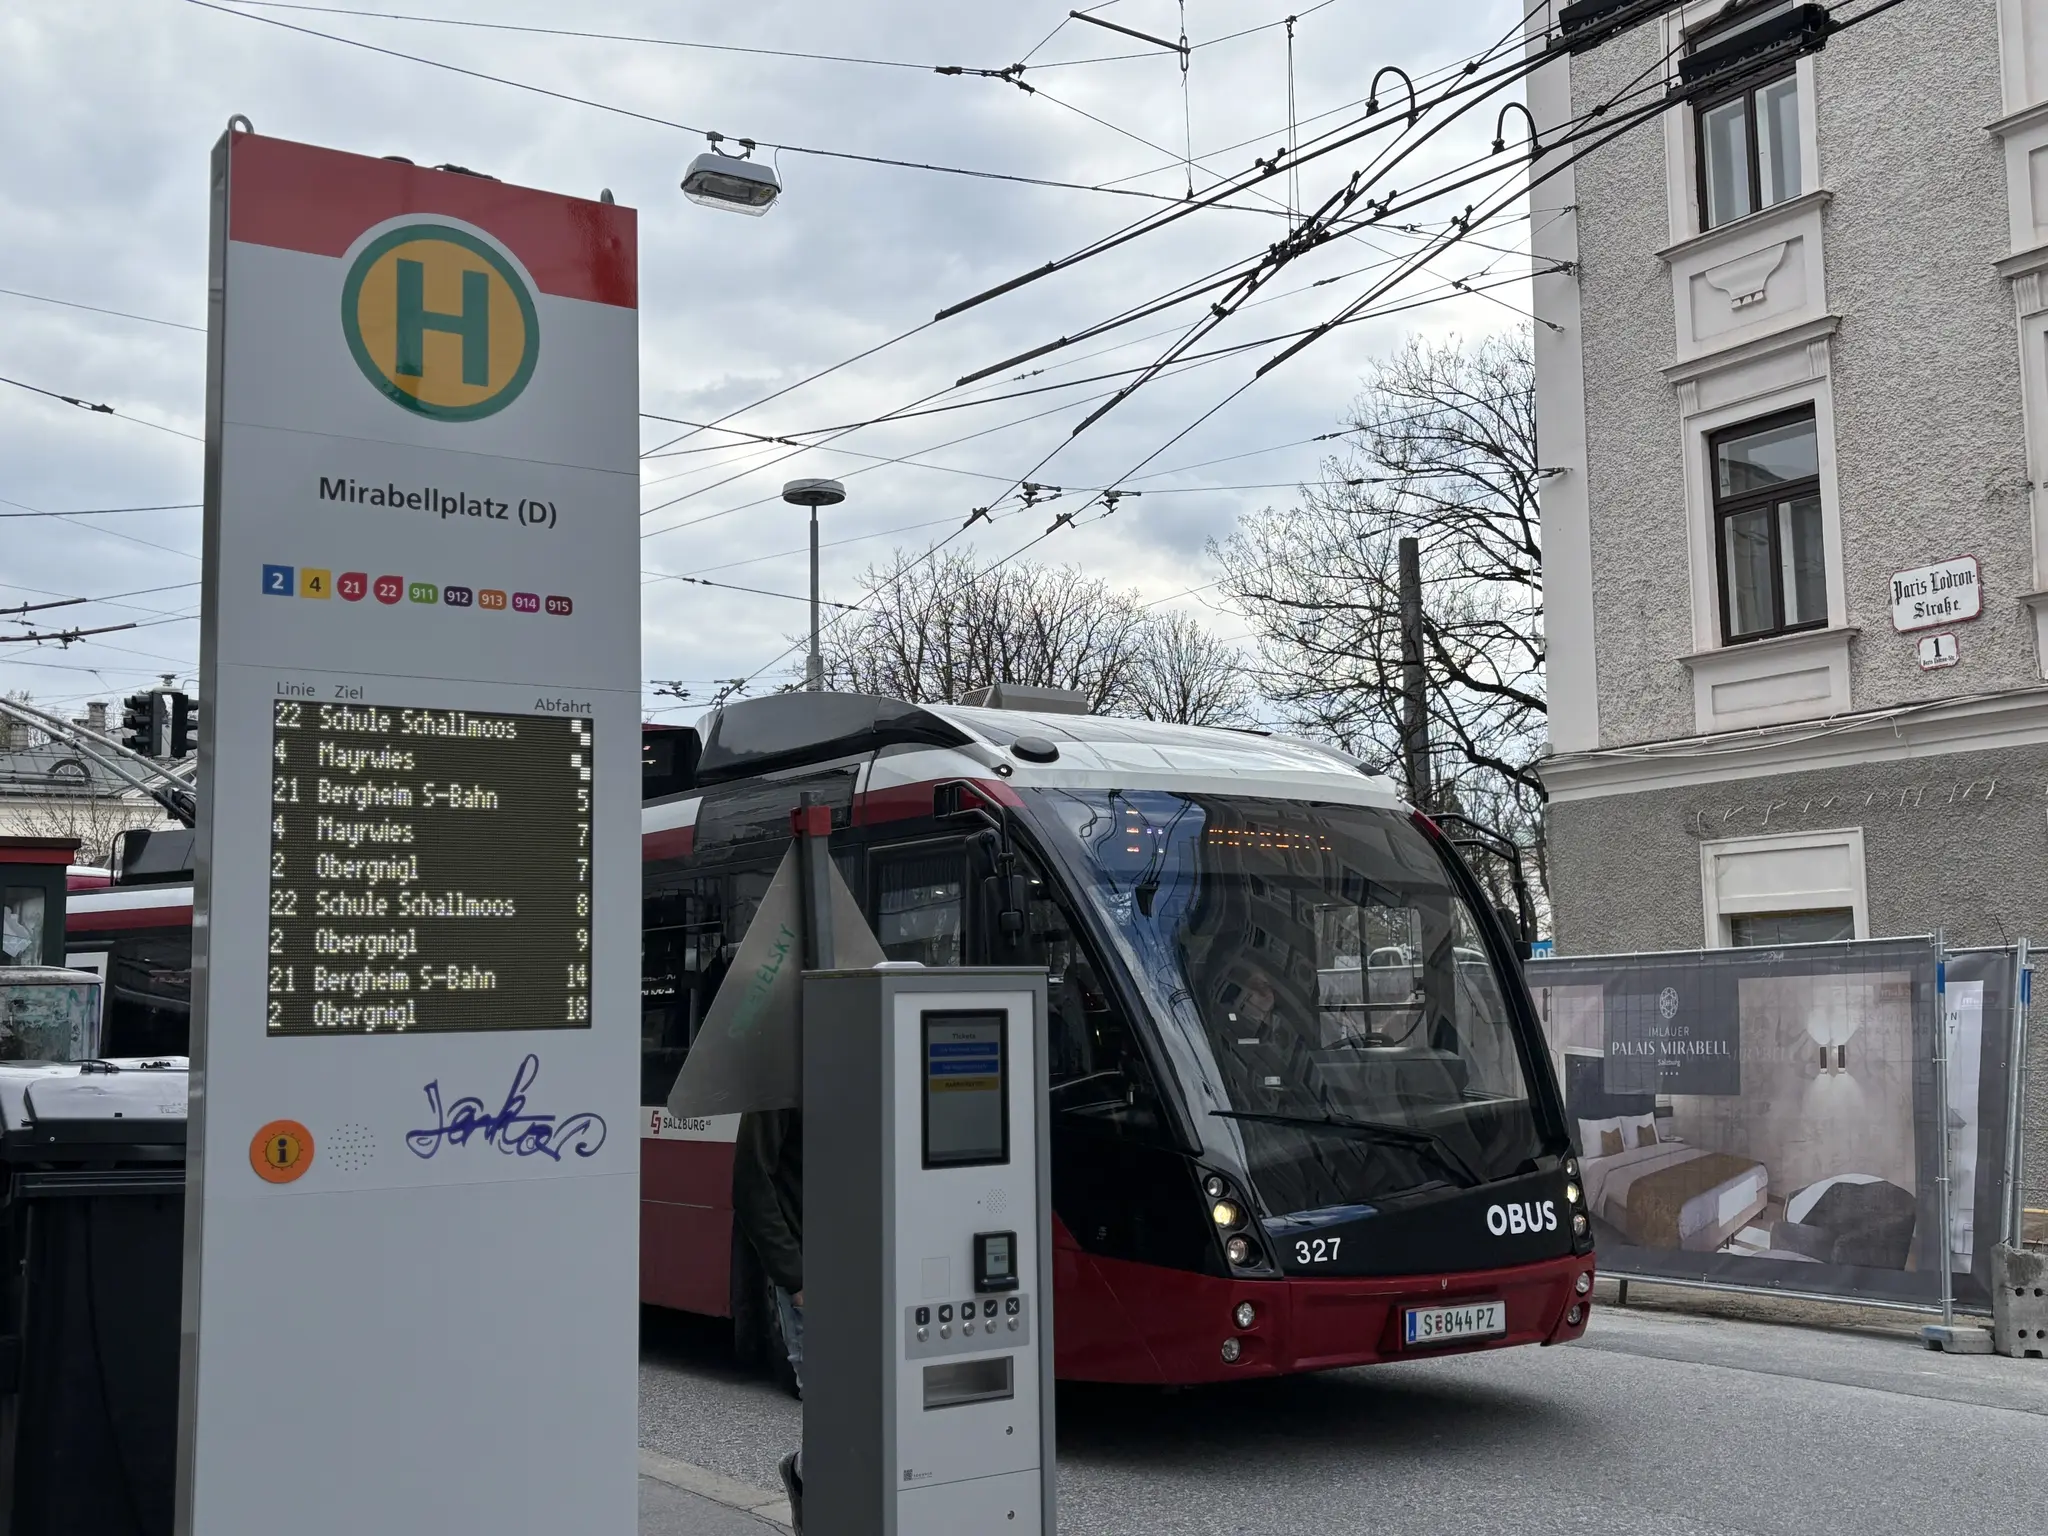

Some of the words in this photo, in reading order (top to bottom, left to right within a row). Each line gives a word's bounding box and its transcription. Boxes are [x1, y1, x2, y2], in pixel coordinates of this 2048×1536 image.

[396, 258, 489, 387] H
[319, 477, 509, 519] Mirabellplatz
[518, 499, 557, 529] (D)
[271, 572, 284, 590] 2
[309, 576, 322, 593] 4
[343, 580, 361, 594] 21
[379, 583, 397, 597] 22
[412, 587, 434, 600] 911
[447, 591, 469, 604] 912
[481, 594, 503, 607] 913
[515, 597, 537, 609] 914
[548, 600, 569, 612] 915
[1893, 578, 1927, 606] Paris
[1933, 637, 1942, 658] 1
[276, 681, 316, 697] Linie
[334, 684, 364, 700] Ziel
[534, 698, 593, 714] Abfahrt
[275, 702, 301, 728] 22
[320, 704, 391, 733] Schule
[401, 709, 518, 739] Schallmoos
[274, 739, 287, 765] 4
[318, 741, 416, 775] Mayrwies
[274, 777, 300, 802] 21
[318, 778, 413, 812] Bergheim
[422, 782, 498, 810] S-Bahn
[577, 789, 589, 812] 5
[273, 814, 286, 840] 4
[317, 815, 415, 848] Mayrwies
[577, 823, 589, 847] 7
[272, 852, 285, 877] 2
[317, 853, 419, 886] Obergnigl
[577, 858, 589, 881] 7
[271, 890, 297, 916] 22
[316, 890, 388, 916] Schule
[399, 891, 517, 917] Schallmoos
[576, 893, 589, 917] 8
[270, 928, 283, 954] 2
[315, 928, 418, 960] Obergnigl
[576, 928, 588, 952] 9
[269, 966, 295, 992] 21
[314, 965, 410, 998] Bergheim
[420, 964, 496, 990] S-Bahn
[566, 963, 588, 988] 14
[268, 1001, 282, 1027] 2
[313, 999, 417, 1032] Obergnigl
[566, 996, 588, 1020] 18
[1612, 1041, 1656, 1056] PALAIS
[1660, 1040, 1730, 1055] MIRABELL
[1648, 1026, 1690, 1037] IMLAUER
[663, 1117, 705, 1131] SALZBURG
[1486, 1200, 1558, 1236] OBUS
[1295, 1237, 1342, 1264] 327
[1476, 1307, 1495, 1330] PZ
